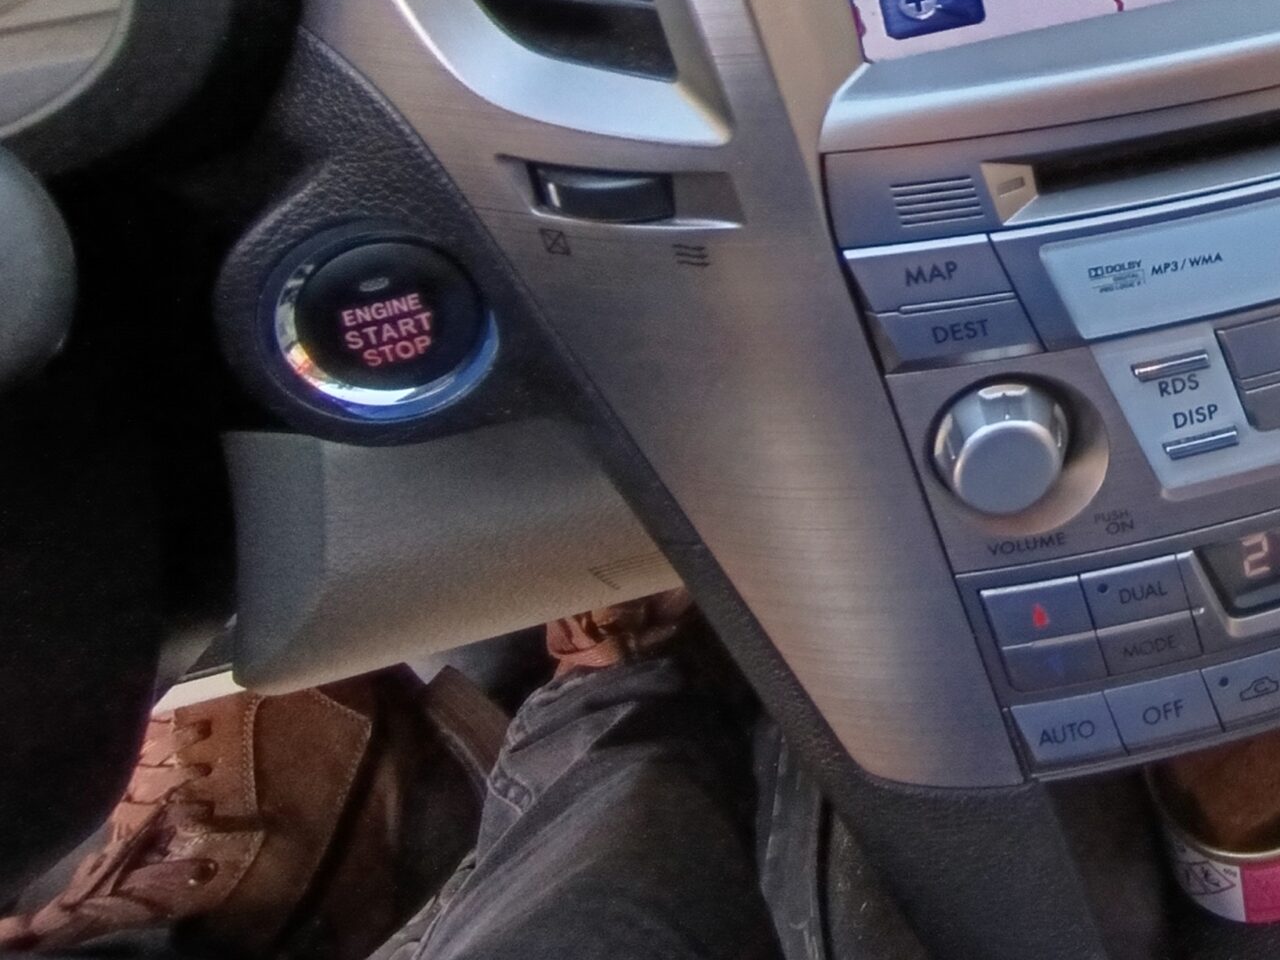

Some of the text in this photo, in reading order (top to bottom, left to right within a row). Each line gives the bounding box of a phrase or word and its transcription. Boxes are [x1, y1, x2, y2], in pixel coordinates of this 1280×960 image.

[905, 261, 958, 287] MAP
[1105, 259, 1142, 274] DOLBY
[341, 293, 422, 327] ENGINE
[345, 311, 432, 350] START
[931, 319, 989, 344] DEST
[363, 335, 432, 367] STOP
[1158, 373, 1200, 397] RDS
[1172, 404, 1219, 429] DISP
[1105, 519, 1134, 535] ON
[987, 532, 1065, 556] VOLUME
[1119, 581, 1167, 604] DUAL
[1123, 635, 1177, 659] MODE
[1142, 698, 1185, 725] OFF
[1038, 719, 1096, 747] AUTO
